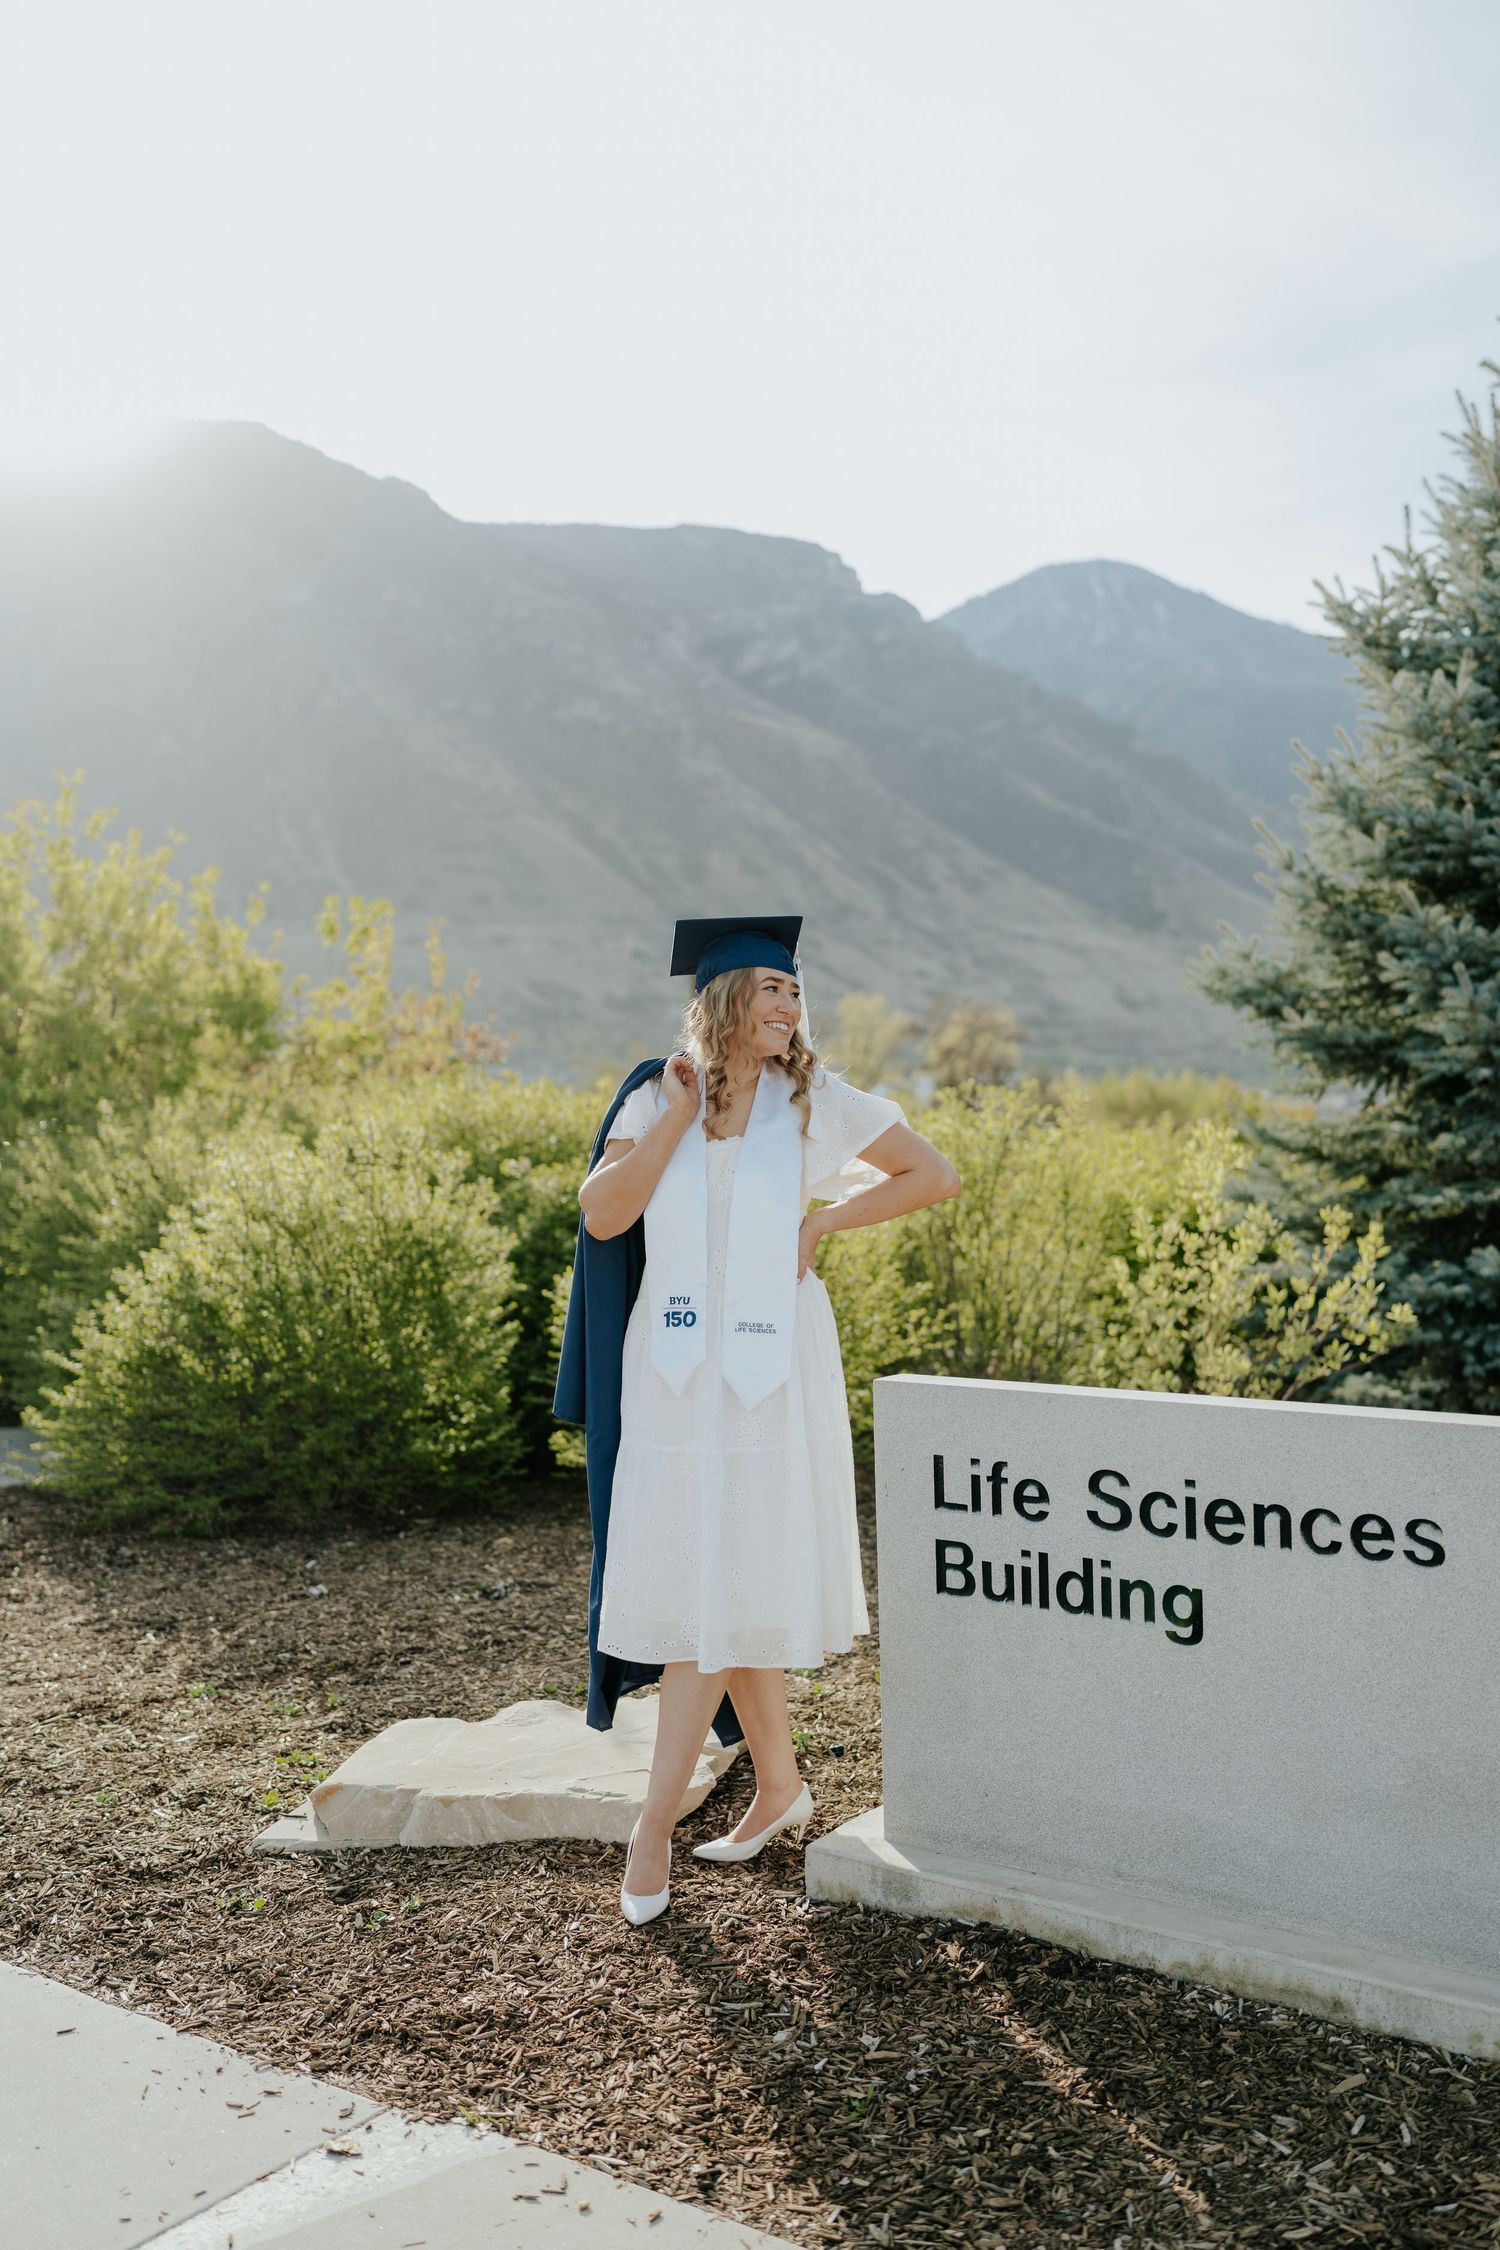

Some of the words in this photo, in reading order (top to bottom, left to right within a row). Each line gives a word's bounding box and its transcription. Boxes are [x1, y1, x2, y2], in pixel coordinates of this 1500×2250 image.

[669, 1296, 691, 1306] BYU
[663, 1311, 697, 1328] 150
[738, 1321, 764, 1329] COLLEGE
[933, 1454, 1050, 1523] Life
[1086, 1469, 1446, 1568] Sciences
[934, 1538, 1204, 1646] Building
